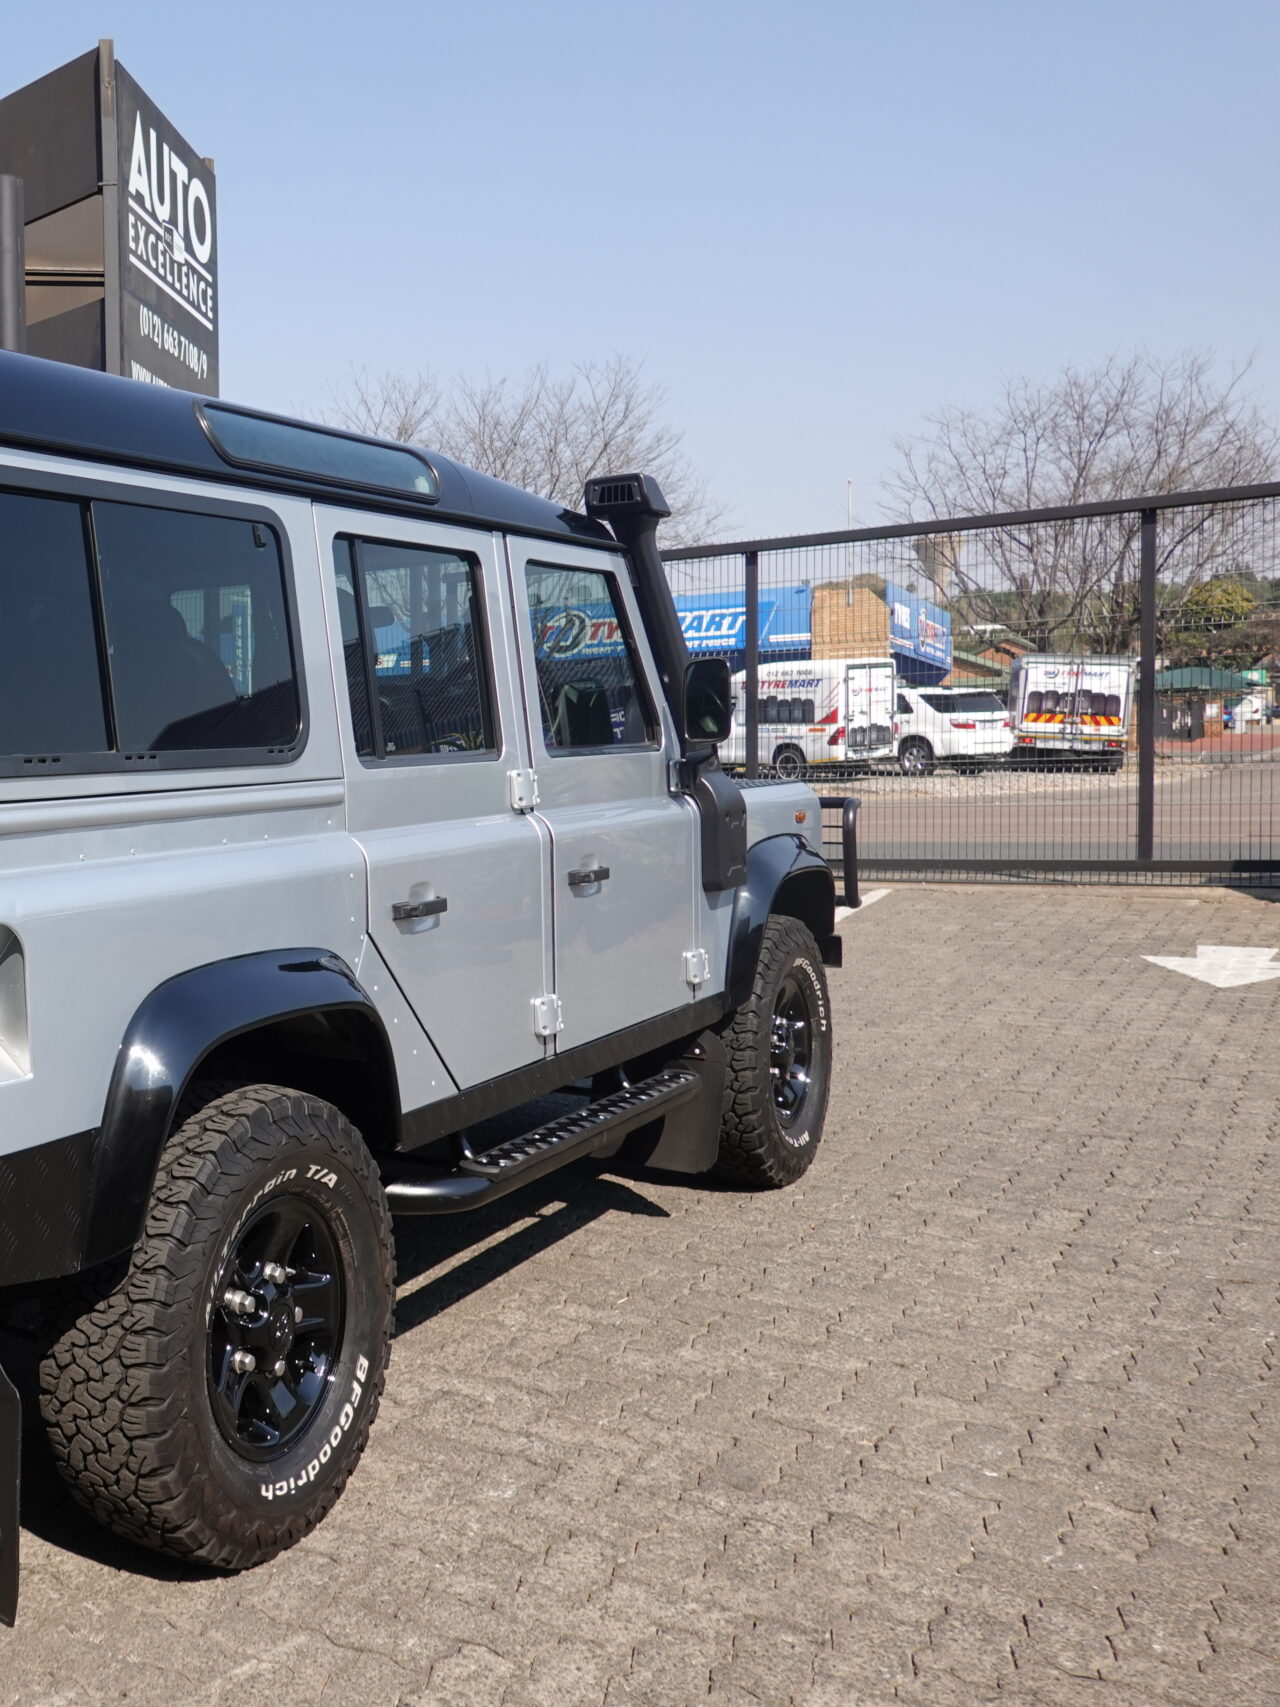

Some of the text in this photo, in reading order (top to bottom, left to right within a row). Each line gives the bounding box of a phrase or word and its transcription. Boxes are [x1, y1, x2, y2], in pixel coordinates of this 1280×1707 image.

[128, 110, 211, 264] AUTO
[129, 212, 213, 319] EXCELLENCE
[140, 304, 207, 379] (012) 663 7108/9
[761, 679, 823, 688] TYREMART
[305, 1164, 338, 1189] T/A
[261, 1354, 369, 1500] BFGoodrich
